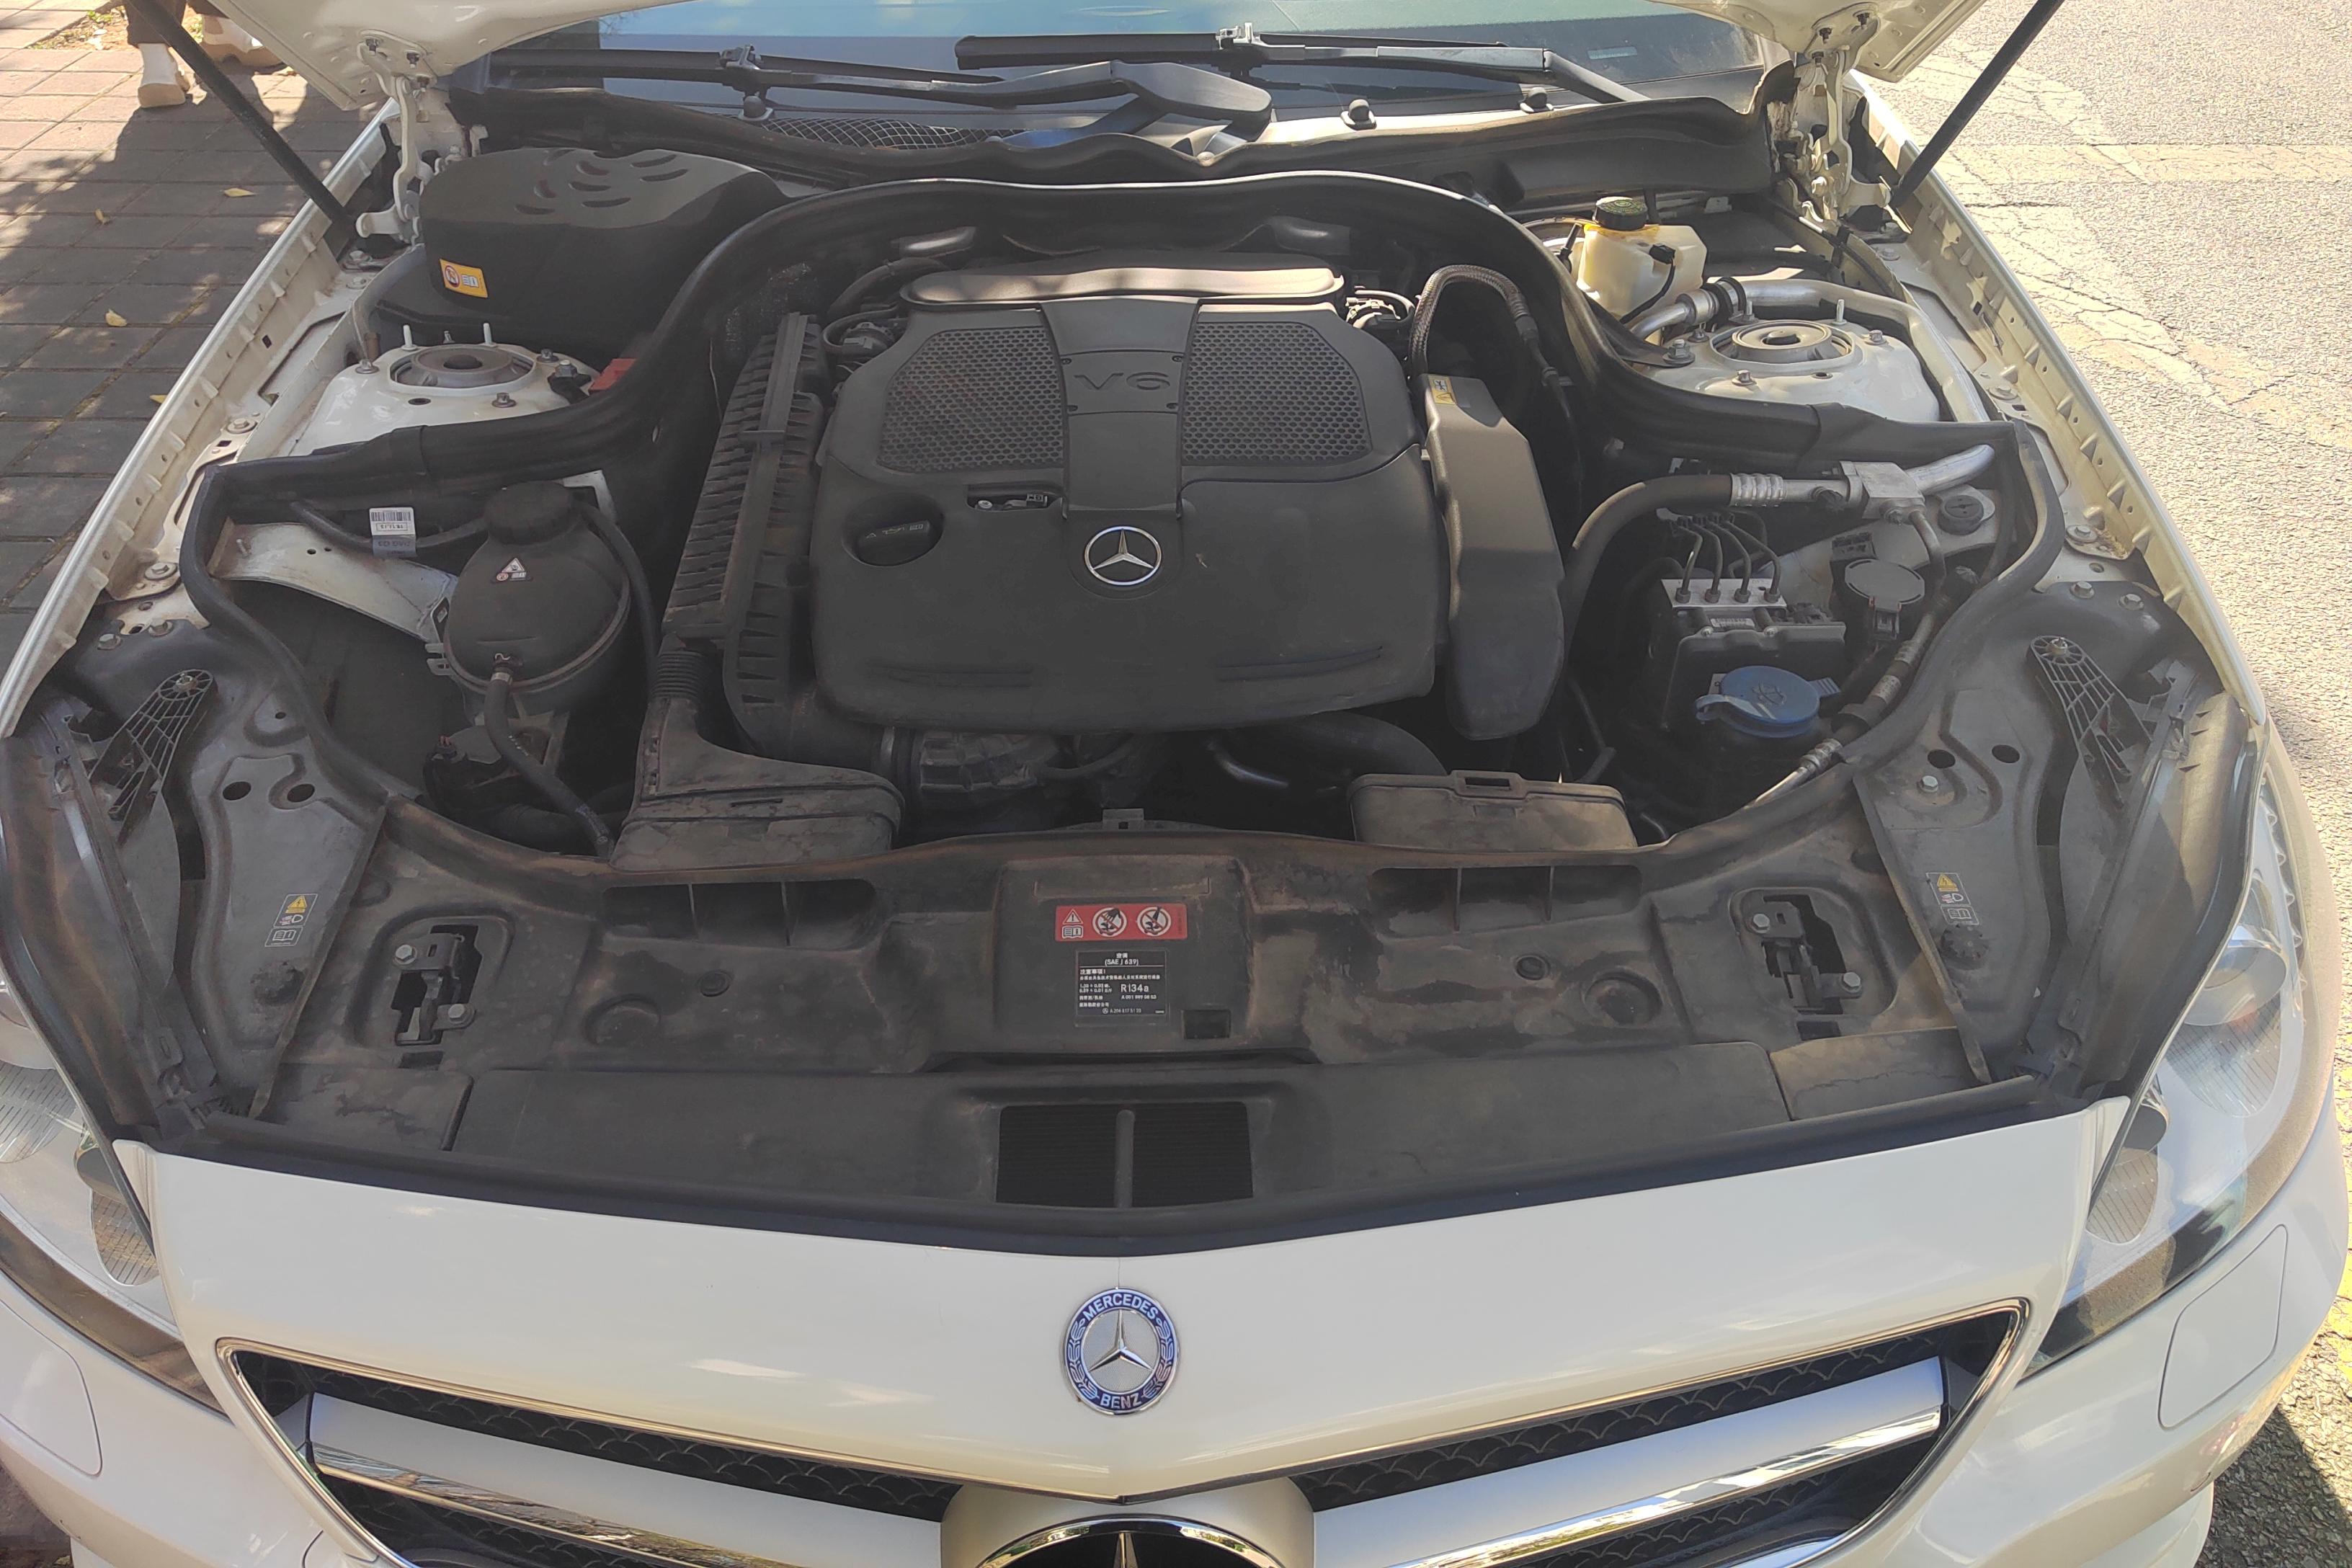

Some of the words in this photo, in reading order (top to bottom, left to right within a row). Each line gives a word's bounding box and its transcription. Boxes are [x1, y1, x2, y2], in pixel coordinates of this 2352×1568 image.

[1074, 372, 1170, 390] V6
[1082, 1293, 1159, 1322] MERCEDES
[1100, 1393, 1142, 1409] BENZ
